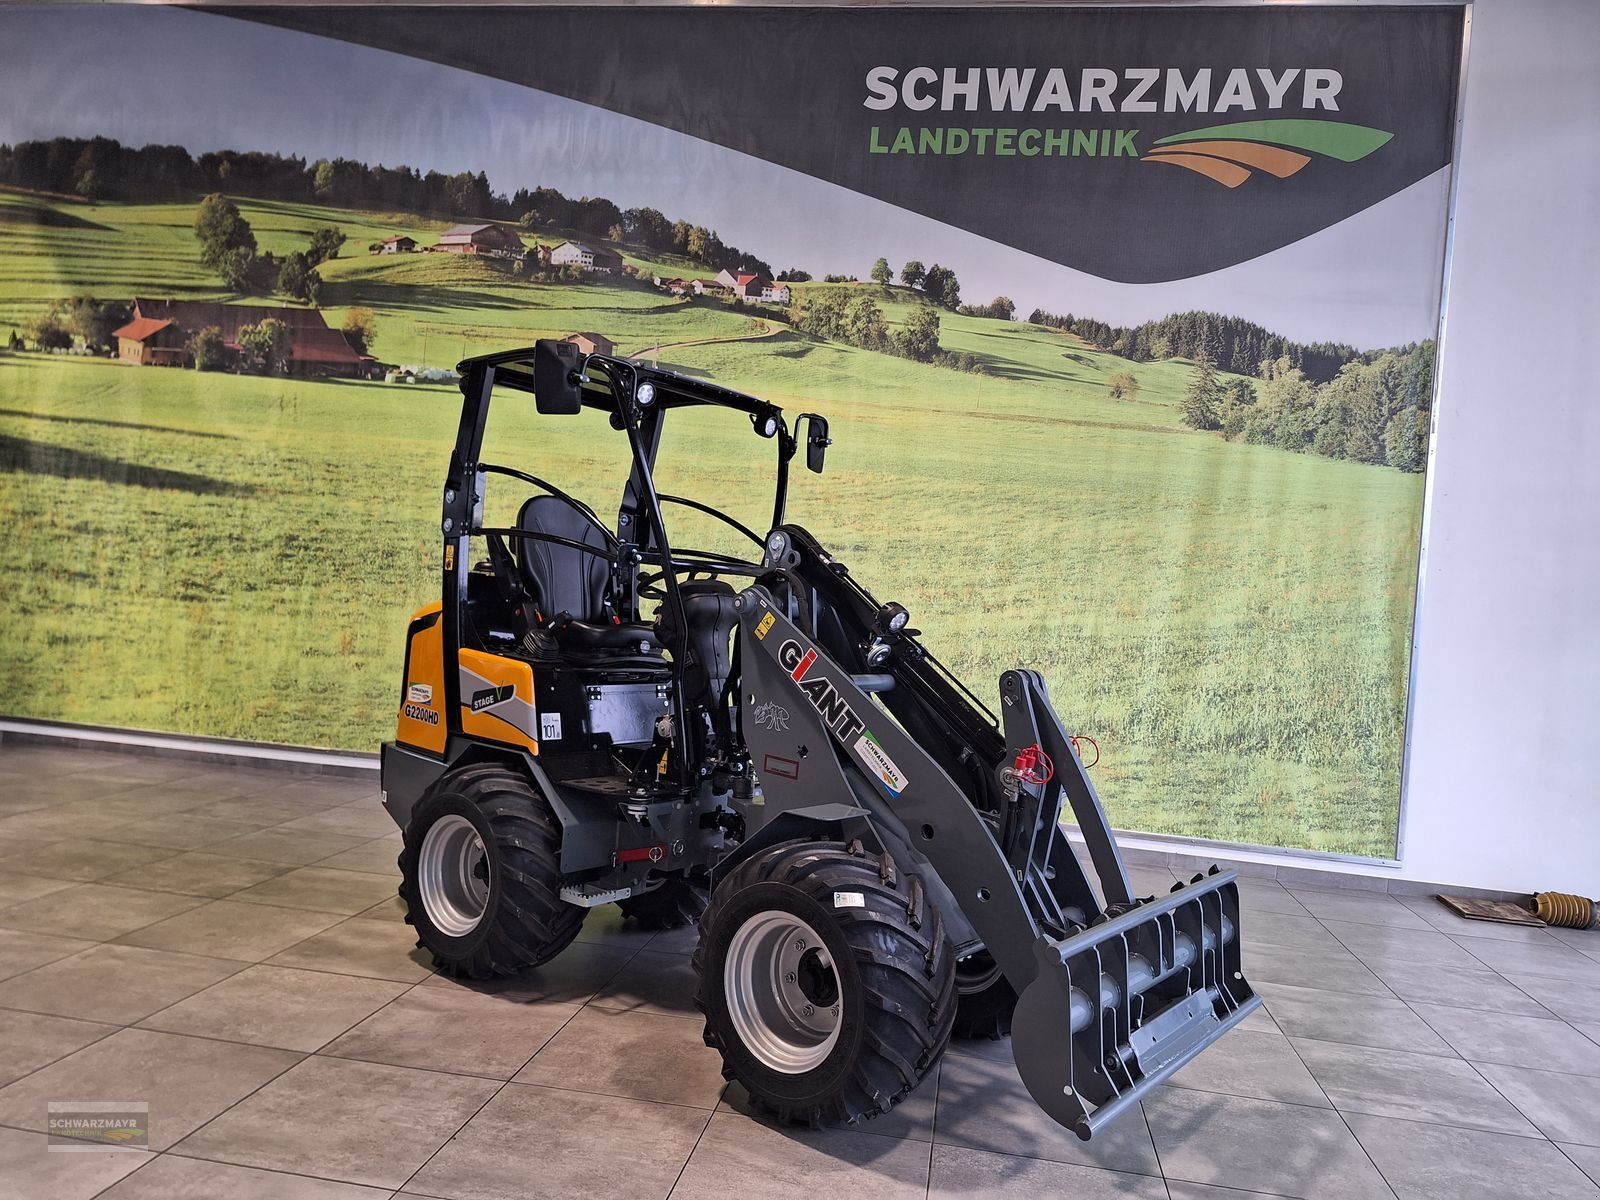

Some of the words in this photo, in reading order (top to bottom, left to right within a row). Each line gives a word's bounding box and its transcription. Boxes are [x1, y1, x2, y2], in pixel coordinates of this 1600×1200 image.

[862, 66, 1344, 113] SCHWARZMAYR
[868, 126, 1140, 157] LANDTECHNIK
[405, 704, 439, 725] G2200HD
[474, 695, 495, 709] STAGE
[543, 724, 556, 738] 101
[865, 739, 899, 782] SCHWARZMAYR
